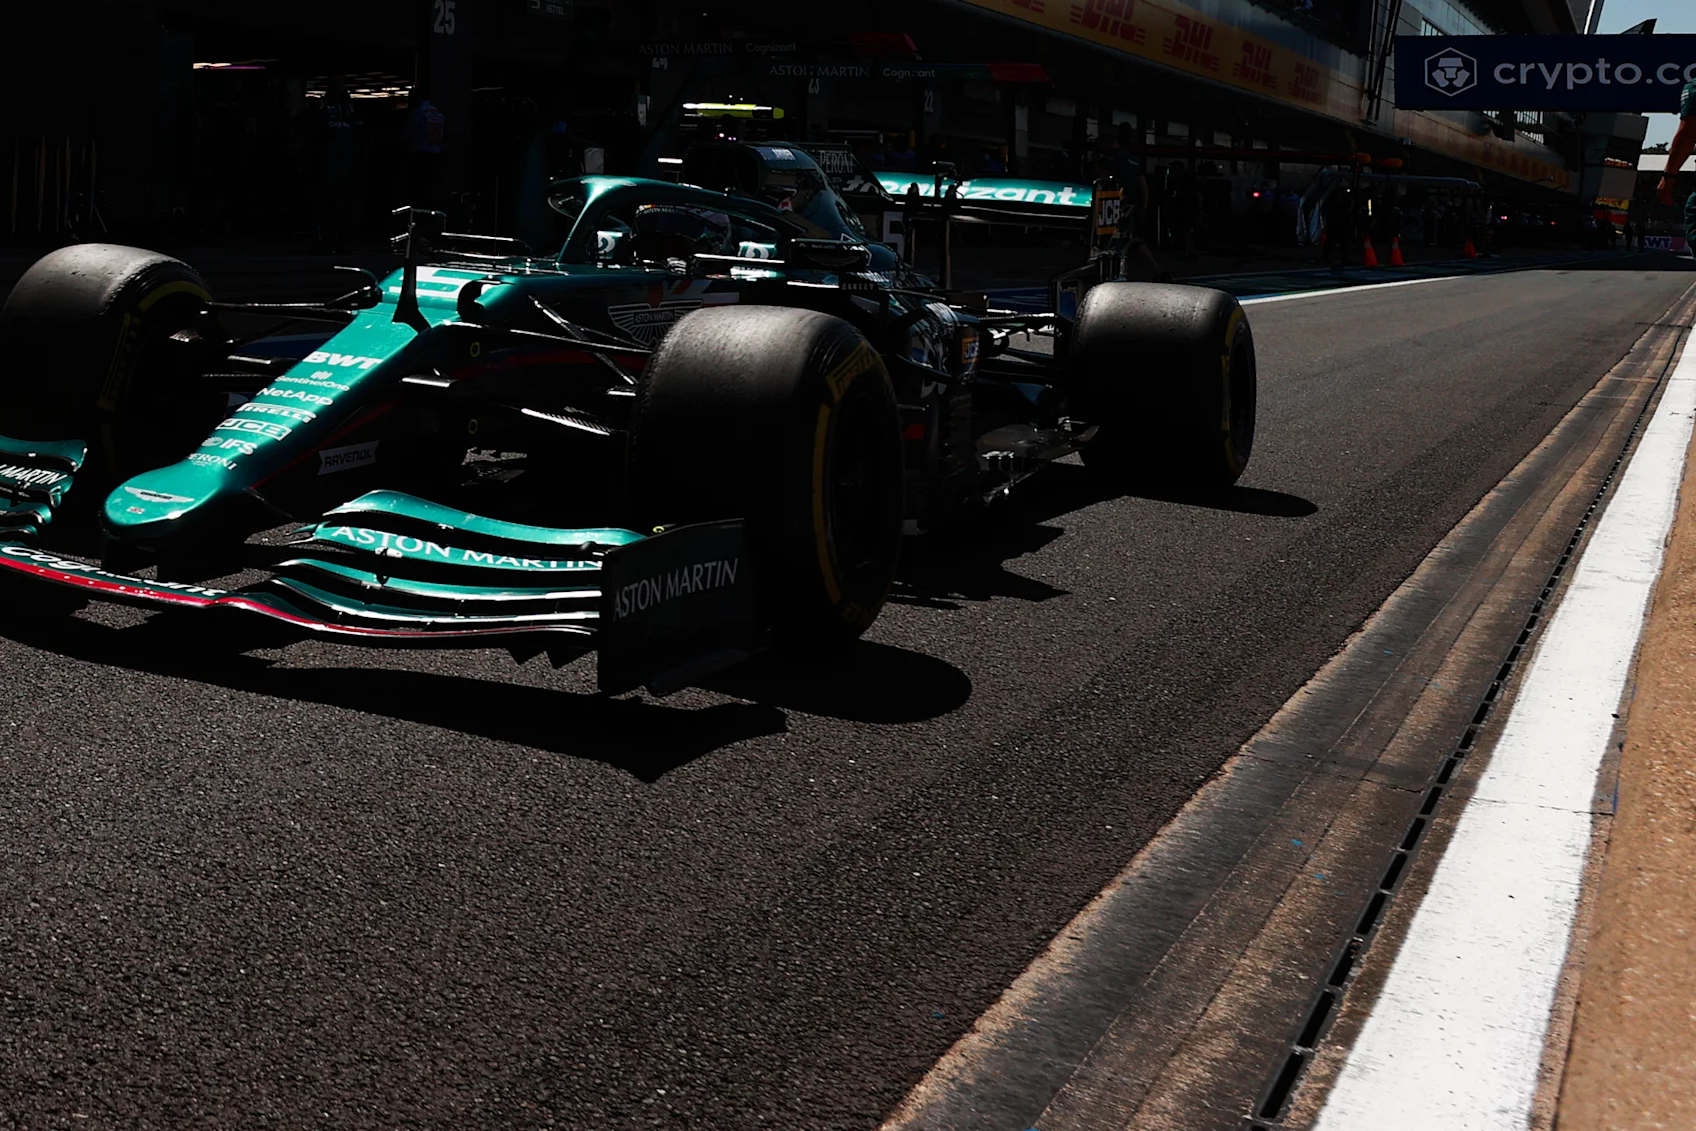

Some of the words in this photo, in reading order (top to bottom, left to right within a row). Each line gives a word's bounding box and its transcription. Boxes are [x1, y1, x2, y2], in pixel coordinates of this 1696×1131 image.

[546, 4, 565, 16] VETTEL
[639, 43, 680, 56] ASTON
[683, 43, 734, 55] MARTIN
[745, 42, 797, 55] Cognizant
[818, 65, 869, 78] MARTIN
[881, 178, 1082, 206] ognizant
[1098, 199, 1121, 226] JCB
[1644, 237, 1670, 248] WT
[634, 314, 653, 324] ASTON
[653, 311, 674, 322] MARTIN
[302, 351, 384, 370] BWT
[274, 375, 350, 392] SentinelOne
[256, 387, 334, 406] NetApp
[236, 402, 317, 424] PIRELLI
[217, 419, 290, 439] JCB
[219, 437, 258, 456] IFS
[324, 448, 373, 468] RAVENOL
[331, 525, 451, 559] ASTON
[462, 549, 603, 569] MARTIN
[613, 574, 663, 623] ASTON
[666, 557, 739, 602] MARTIN
